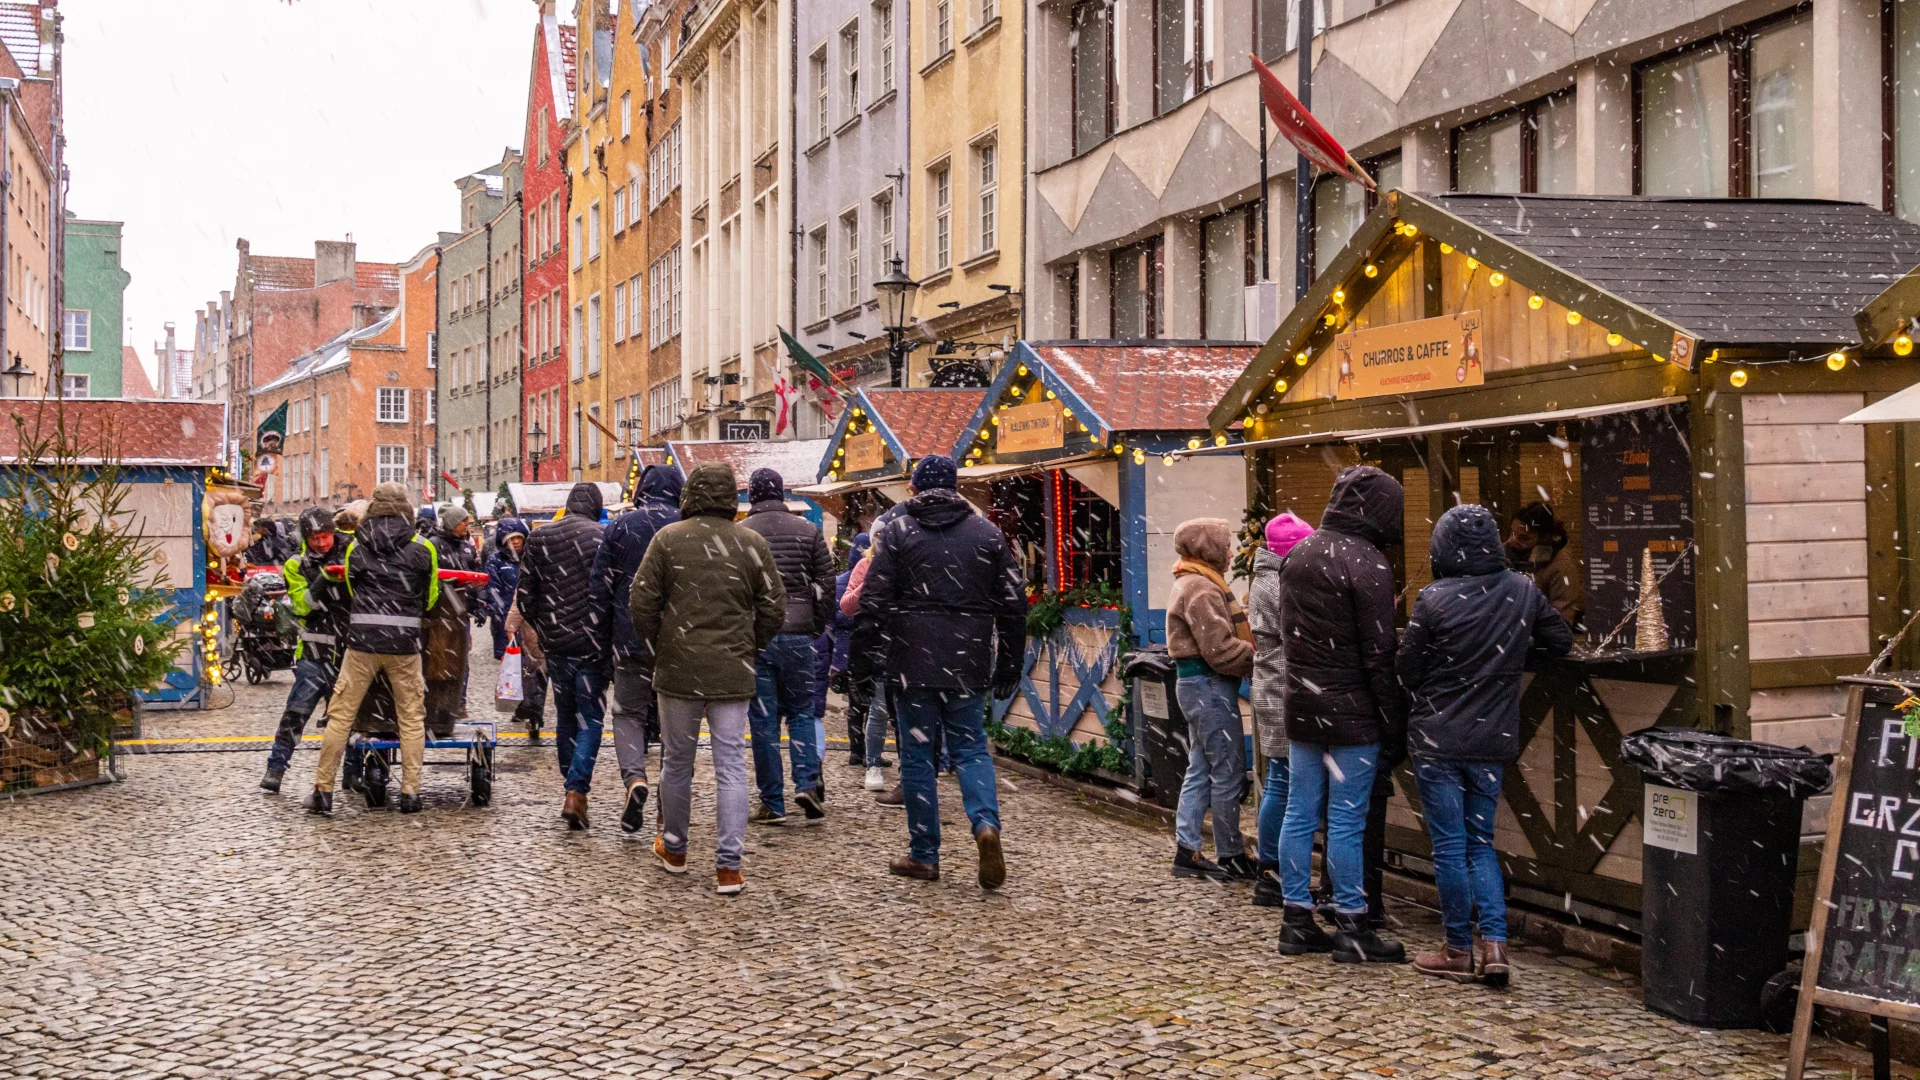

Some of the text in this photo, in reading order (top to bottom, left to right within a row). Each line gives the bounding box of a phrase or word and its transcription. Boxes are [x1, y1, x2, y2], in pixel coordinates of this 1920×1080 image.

[1363, 340, 1449, 367] CHURROS & CAFFE
[1652, 793, 1670, 805] pre
[1652, 806, 1676, 820] zero
